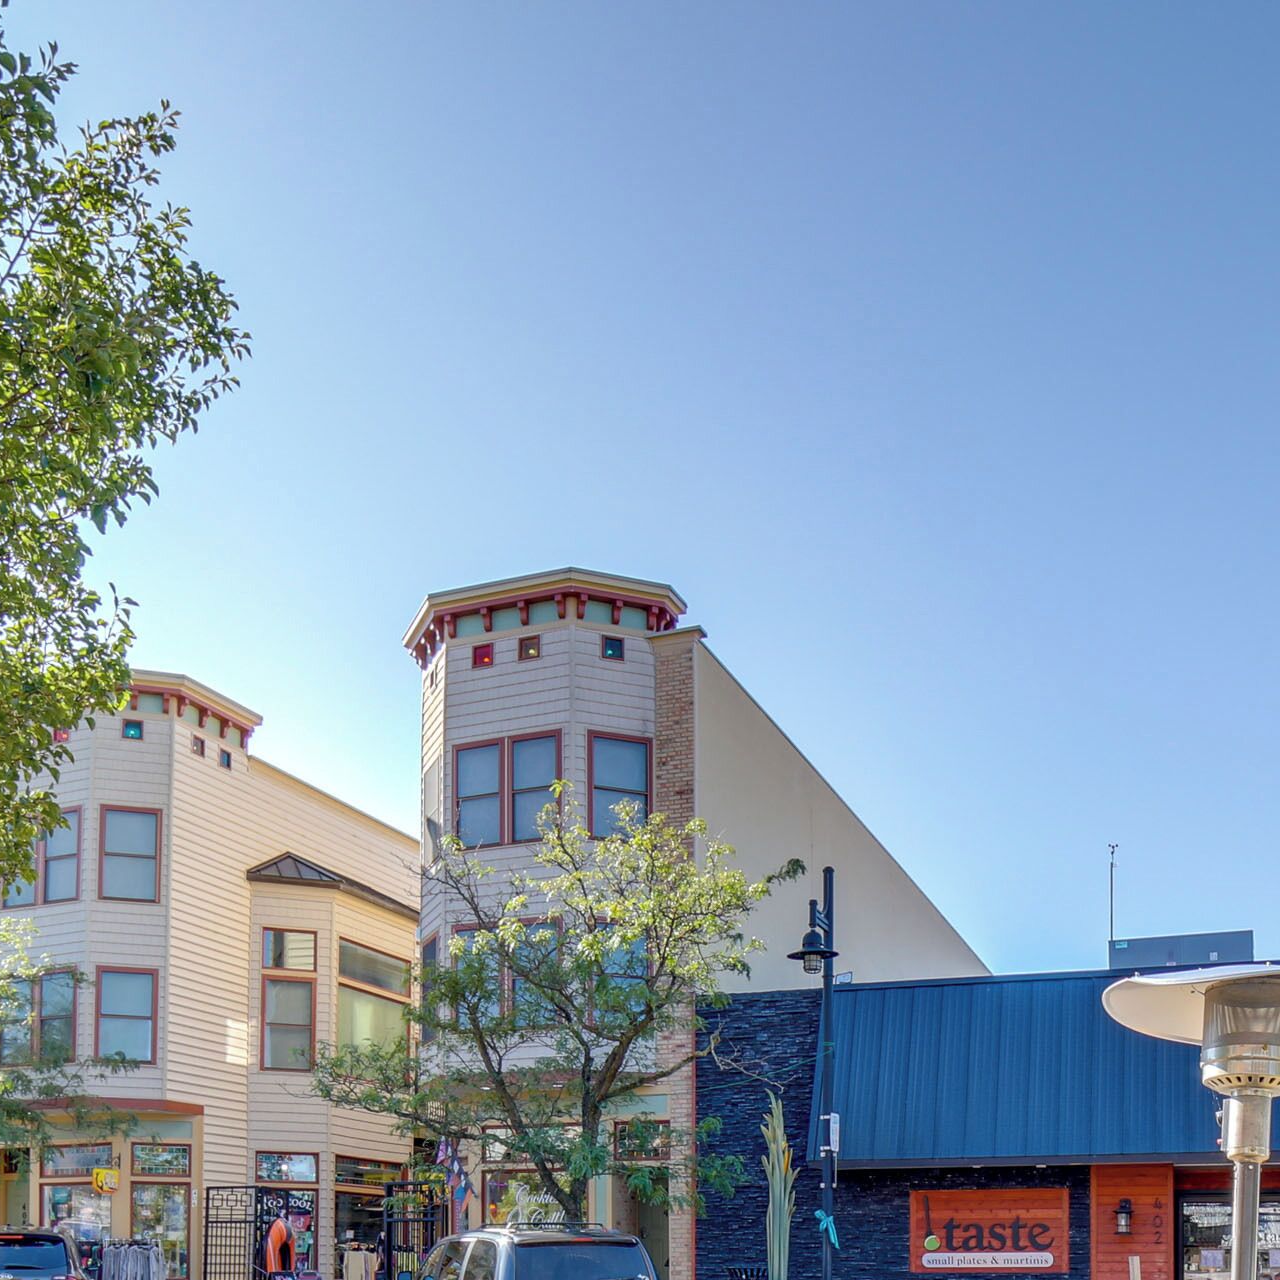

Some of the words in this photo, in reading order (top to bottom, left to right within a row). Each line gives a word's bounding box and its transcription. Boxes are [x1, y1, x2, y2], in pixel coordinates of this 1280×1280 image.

[943, 1216, 1055, 1251] taste
[1153, 1198, 1163, 1244] 402
[926, 1256, 954, 1265] small
[957, 1256, 987, 1267] plates
[990, 1256, 999, 1265] &
[1003, 1256, 1049, 1265] martinis
